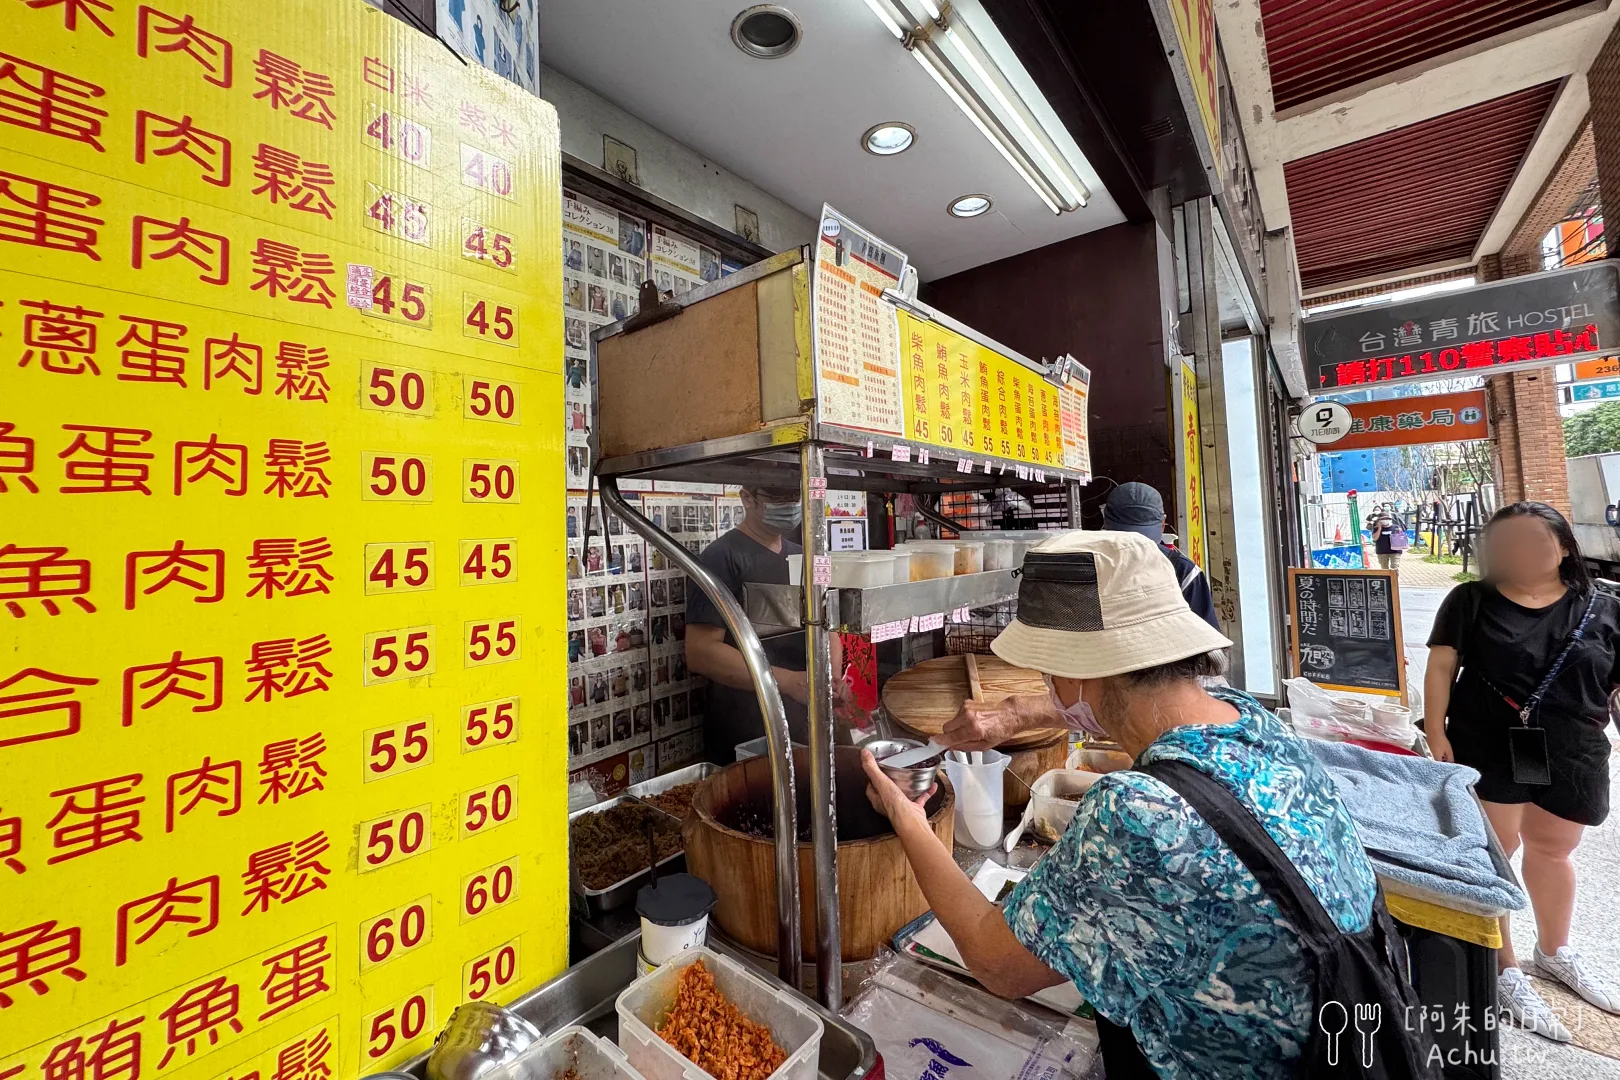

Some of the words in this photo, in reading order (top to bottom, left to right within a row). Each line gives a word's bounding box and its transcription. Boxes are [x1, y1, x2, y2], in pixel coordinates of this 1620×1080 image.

[0, 51, 336, 220] 蛋肉鬆
[368, 193, 429, 240] 45
[464, 225, 513, 268] 45
[366, 112, 424, 161] 40
[464, 152, 511, 196] 40
[0, 170, 336, 310] 蛋肉鬆
[371, 275, 426, 323] 45
[466, 300, 514, 342] 45
[0, 299, 332, 405] 蔥蛋肉鬆
[369, 367, 425, 411] 50
[469, 381, 515, 420] 50
[1359, 311, 1500, 353] 台灣青旅
[1507, 302, 1595, 331] HOSTEL
[911, 331, 927, 414] 柴魚肉鬆
[936, 342, 951, 421] 鮪魚肉鬆
[959, 352, 972, 426] 玉米肉鬆
[915, 418, 929, 440] 45
[941, 426, 953, 444] 50
[963, 431, 974, 447] 45
[983, 436, 994, 453] 55
[1001, 440, 1011, 456] 55
[1017, 444, 1026, 459] 50
[1031, 447, 1040, 461] 50
[1045, 450, 1053, 464] 45
[369, 456, 427, 497] 50
[469, 464, 516, 500] 50
[0, 537, 335, 619] 魚肉鬆
[369, 548, 429, 588] 45
[462, 543, 512, 580] 45
[1298, 575, 1318, 636] 夏の時間だ
[0, 634, 334, 748] 合肉鬆
[370, 632, 430, 678] 55
[468, 621, 516, 662] 55
[369, 722, 428, 773] 55
[465, 703, 514, 747] 55
[0, 831, 331, 1009] 魚肉鬆
[366, 811, 425, 865] 50
[464, 783, 512, 831] 50
[0, 936, 332, 1080] 鮪魚蛋
[365, 905, 425, 963] 60
[465, 866, 513, 915] 60
[368, 995, 426, 1059] 50
[468, 945, 516, 1000] 50
